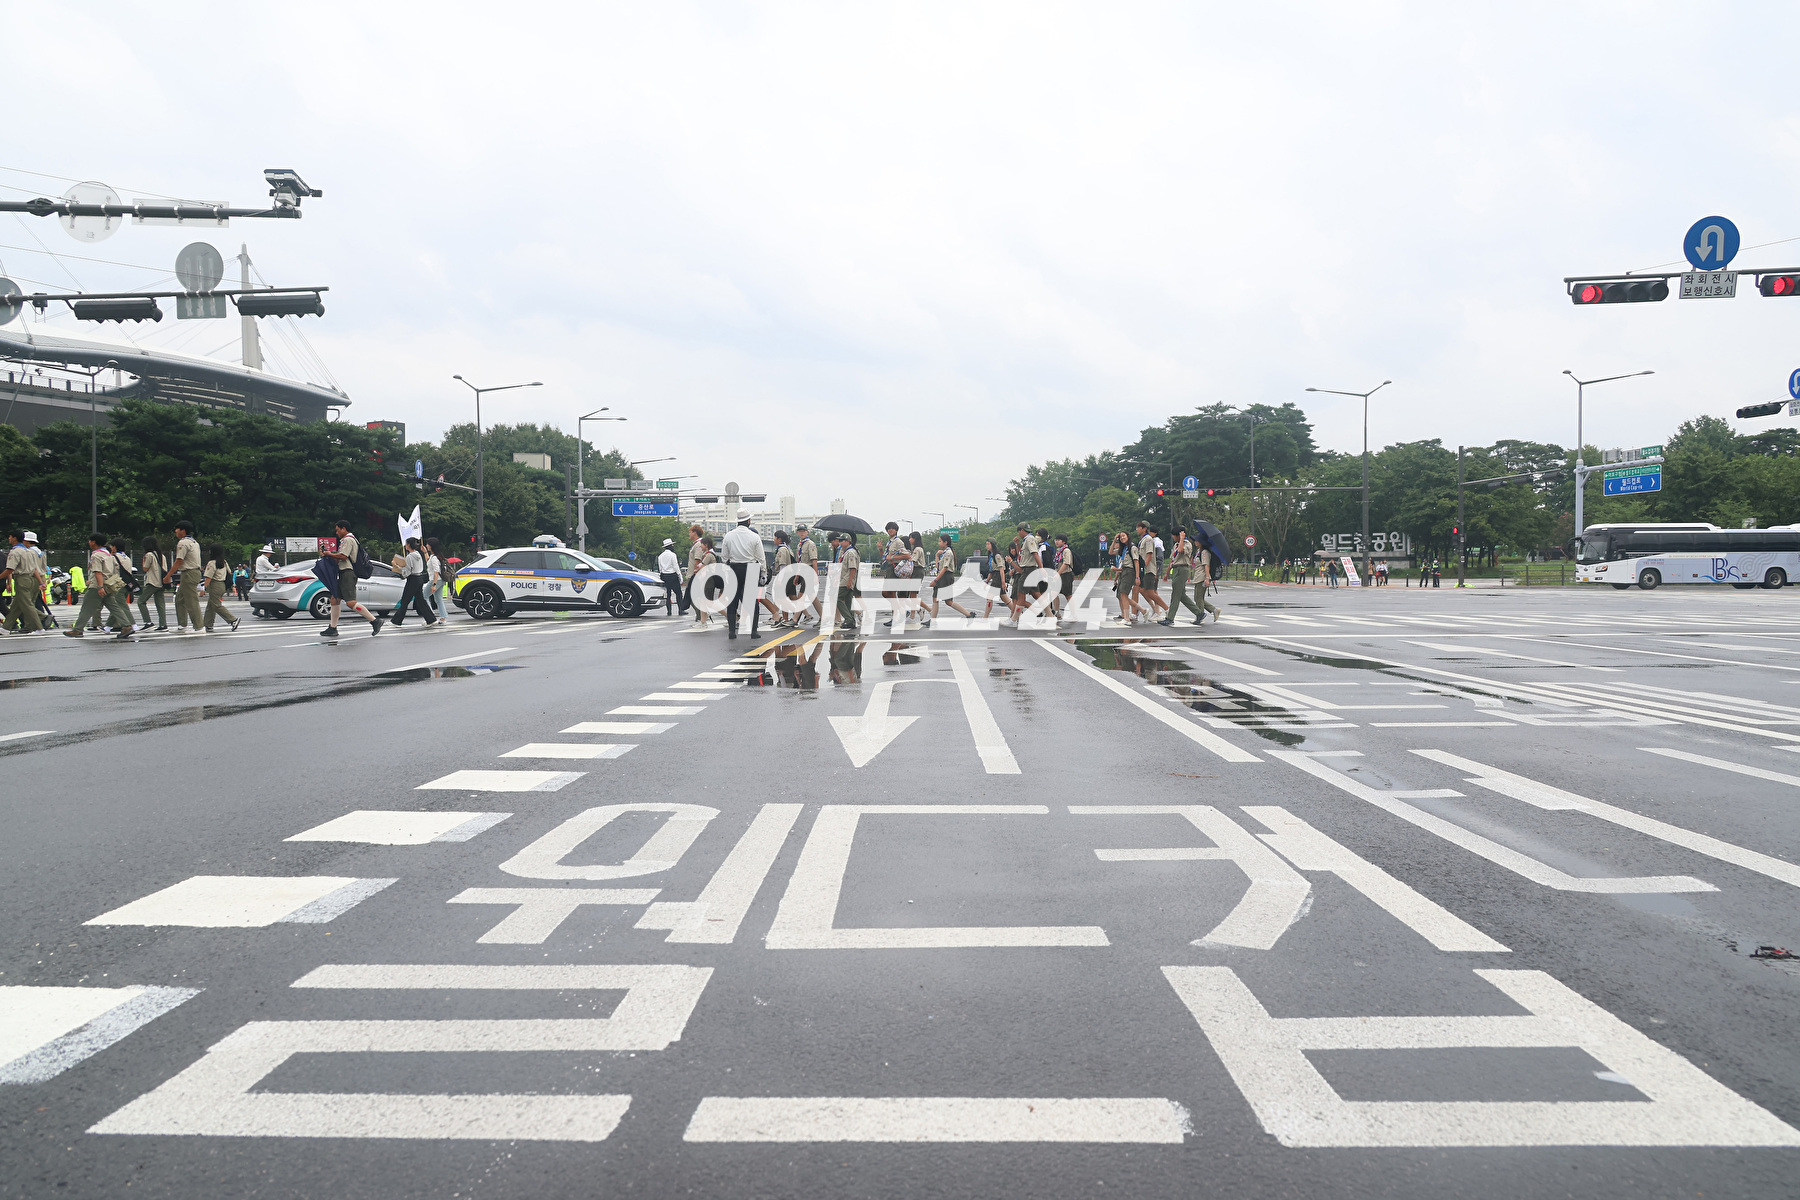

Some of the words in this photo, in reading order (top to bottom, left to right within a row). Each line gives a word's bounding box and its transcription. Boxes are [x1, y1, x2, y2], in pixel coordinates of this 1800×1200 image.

[1682, 285, 1733, 297] 보행신호시
[510, 581, 538, 590] POLICE
[547, 583, 562, 592] 경찰
